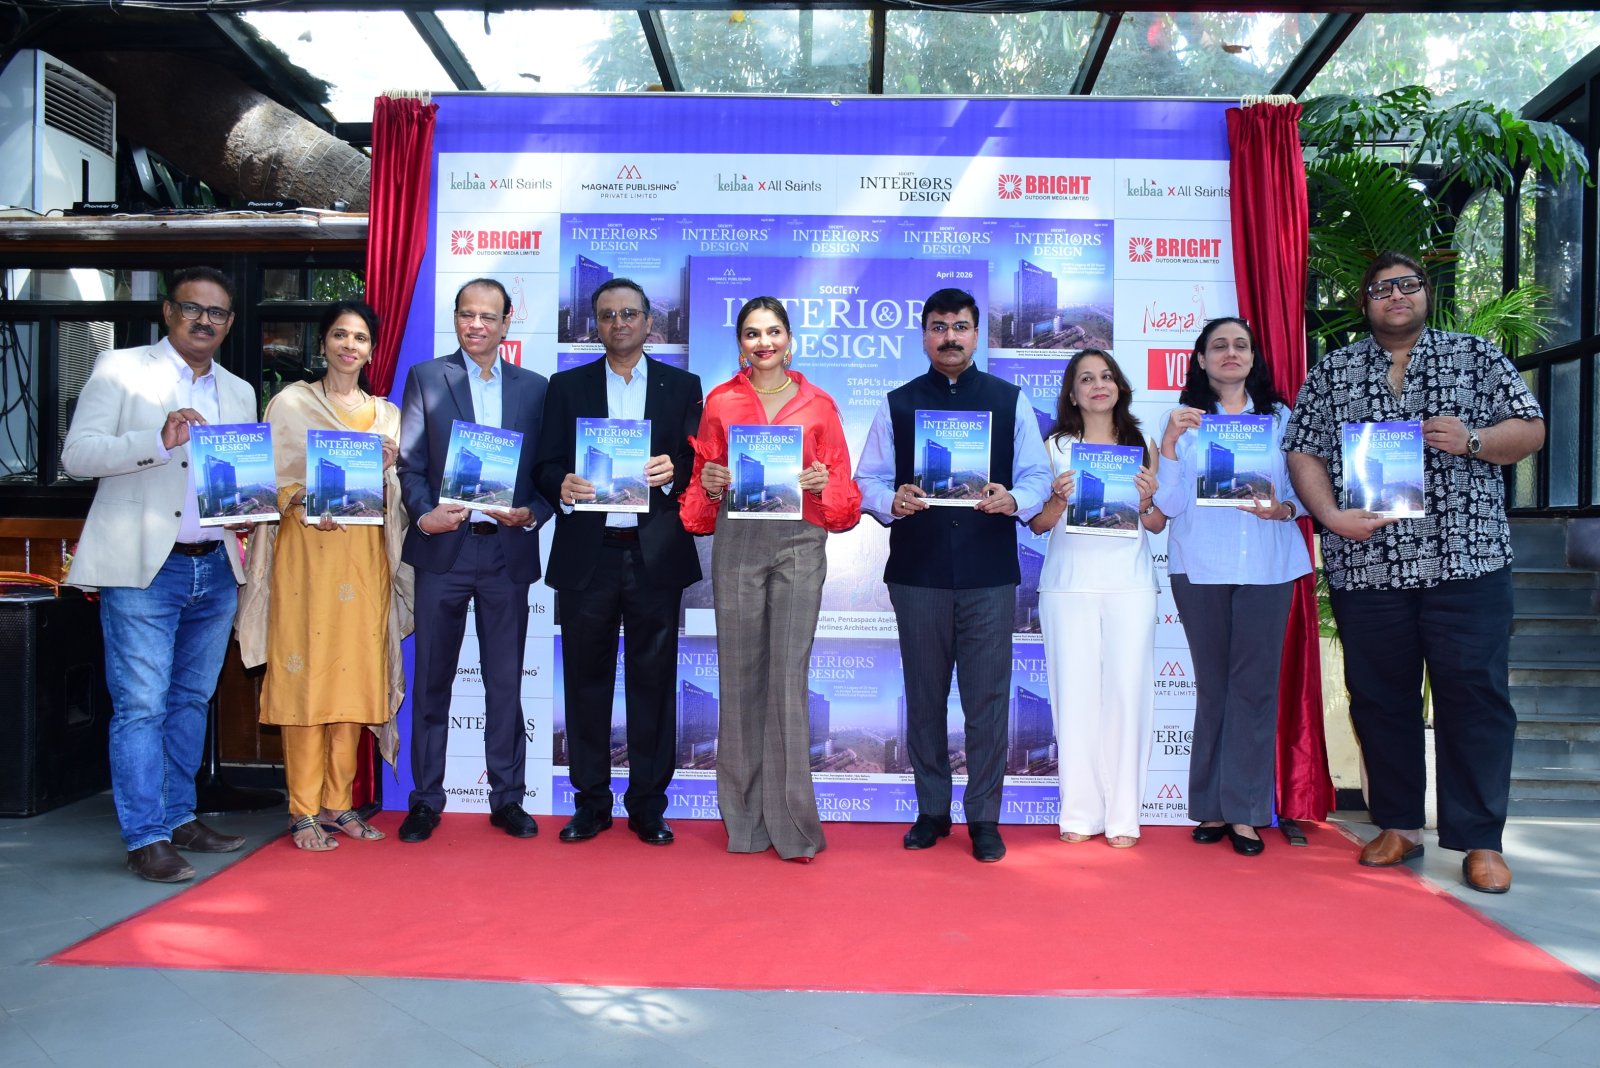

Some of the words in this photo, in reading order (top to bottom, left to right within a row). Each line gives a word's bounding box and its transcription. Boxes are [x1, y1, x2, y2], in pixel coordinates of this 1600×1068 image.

[500, 179, 513, 189] All
[516, 178, 552, 189] Saints
[768, 180, 782, 191] All
[785, 180, 822, 192] Saints
[1026, 175, 1091, 194] BRIGHT
[1177, 186, 1191, 197] All
[1194, 186, 1230, 197] Saints
[900, 192, 951, 202] DESIGN
[478, 230, 542, 249] BRIGHT
[590, 242, 639, 251] DESIGN
[701, 242, 749, 251] DESIGN
[811, 243, 860, 253] DESIGN
[922, 244, 971, 254] DESIGN
[1034, 246, 1082, 257] DESIGN
[1156, 239, 1221, 258] BRIGHT
[819, 286, 859, 295] SOCIETY
[1165, 353, 1190, 387] VO
[936, 430, 968, 438] DESIGN
[215, 443, 251, 452] DESIGN
[470, 440, 502, 452] DESIGN
[1090, 462, 1122, 470] DESIGN
[1164, 745, 1190, 755] DES
[820, 812, 852, 821] SIGN
